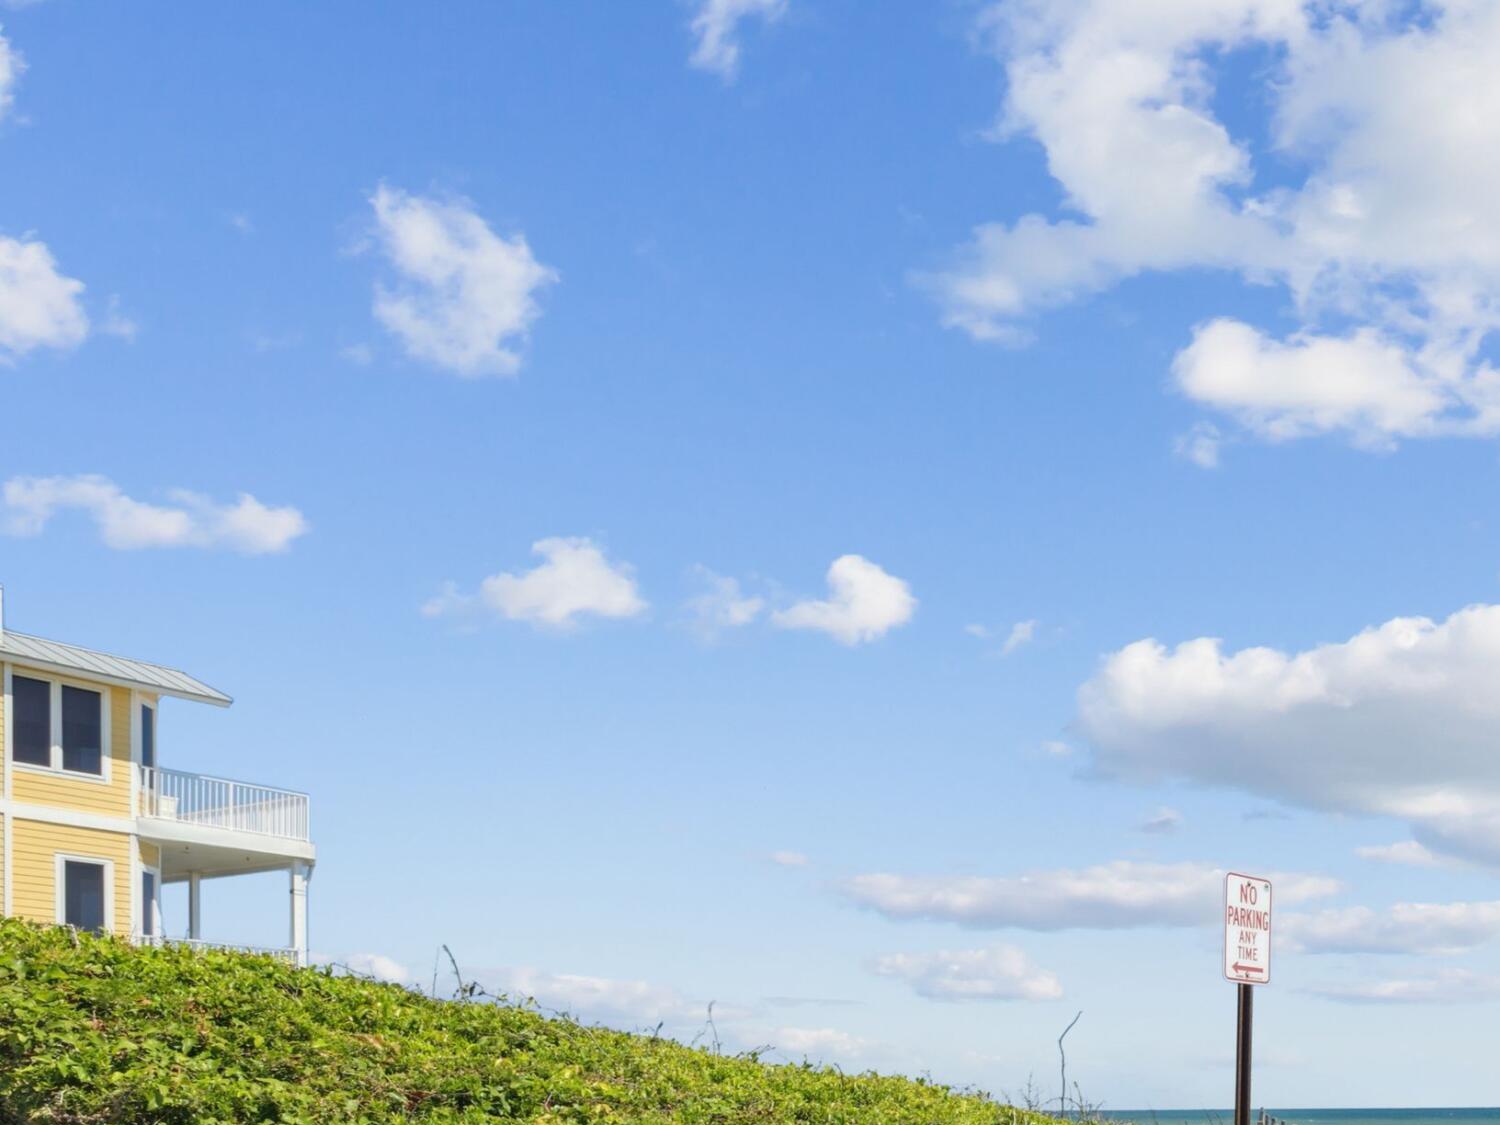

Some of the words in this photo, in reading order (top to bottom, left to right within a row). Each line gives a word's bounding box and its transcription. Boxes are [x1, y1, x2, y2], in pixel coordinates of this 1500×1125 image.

[1240, 883, 1257, 905] NO
[1228, 905, 1268, 931] PARKING
[1239, 930, 1257, 945] ANY
[1238, 945, 1258, 961] TIME
